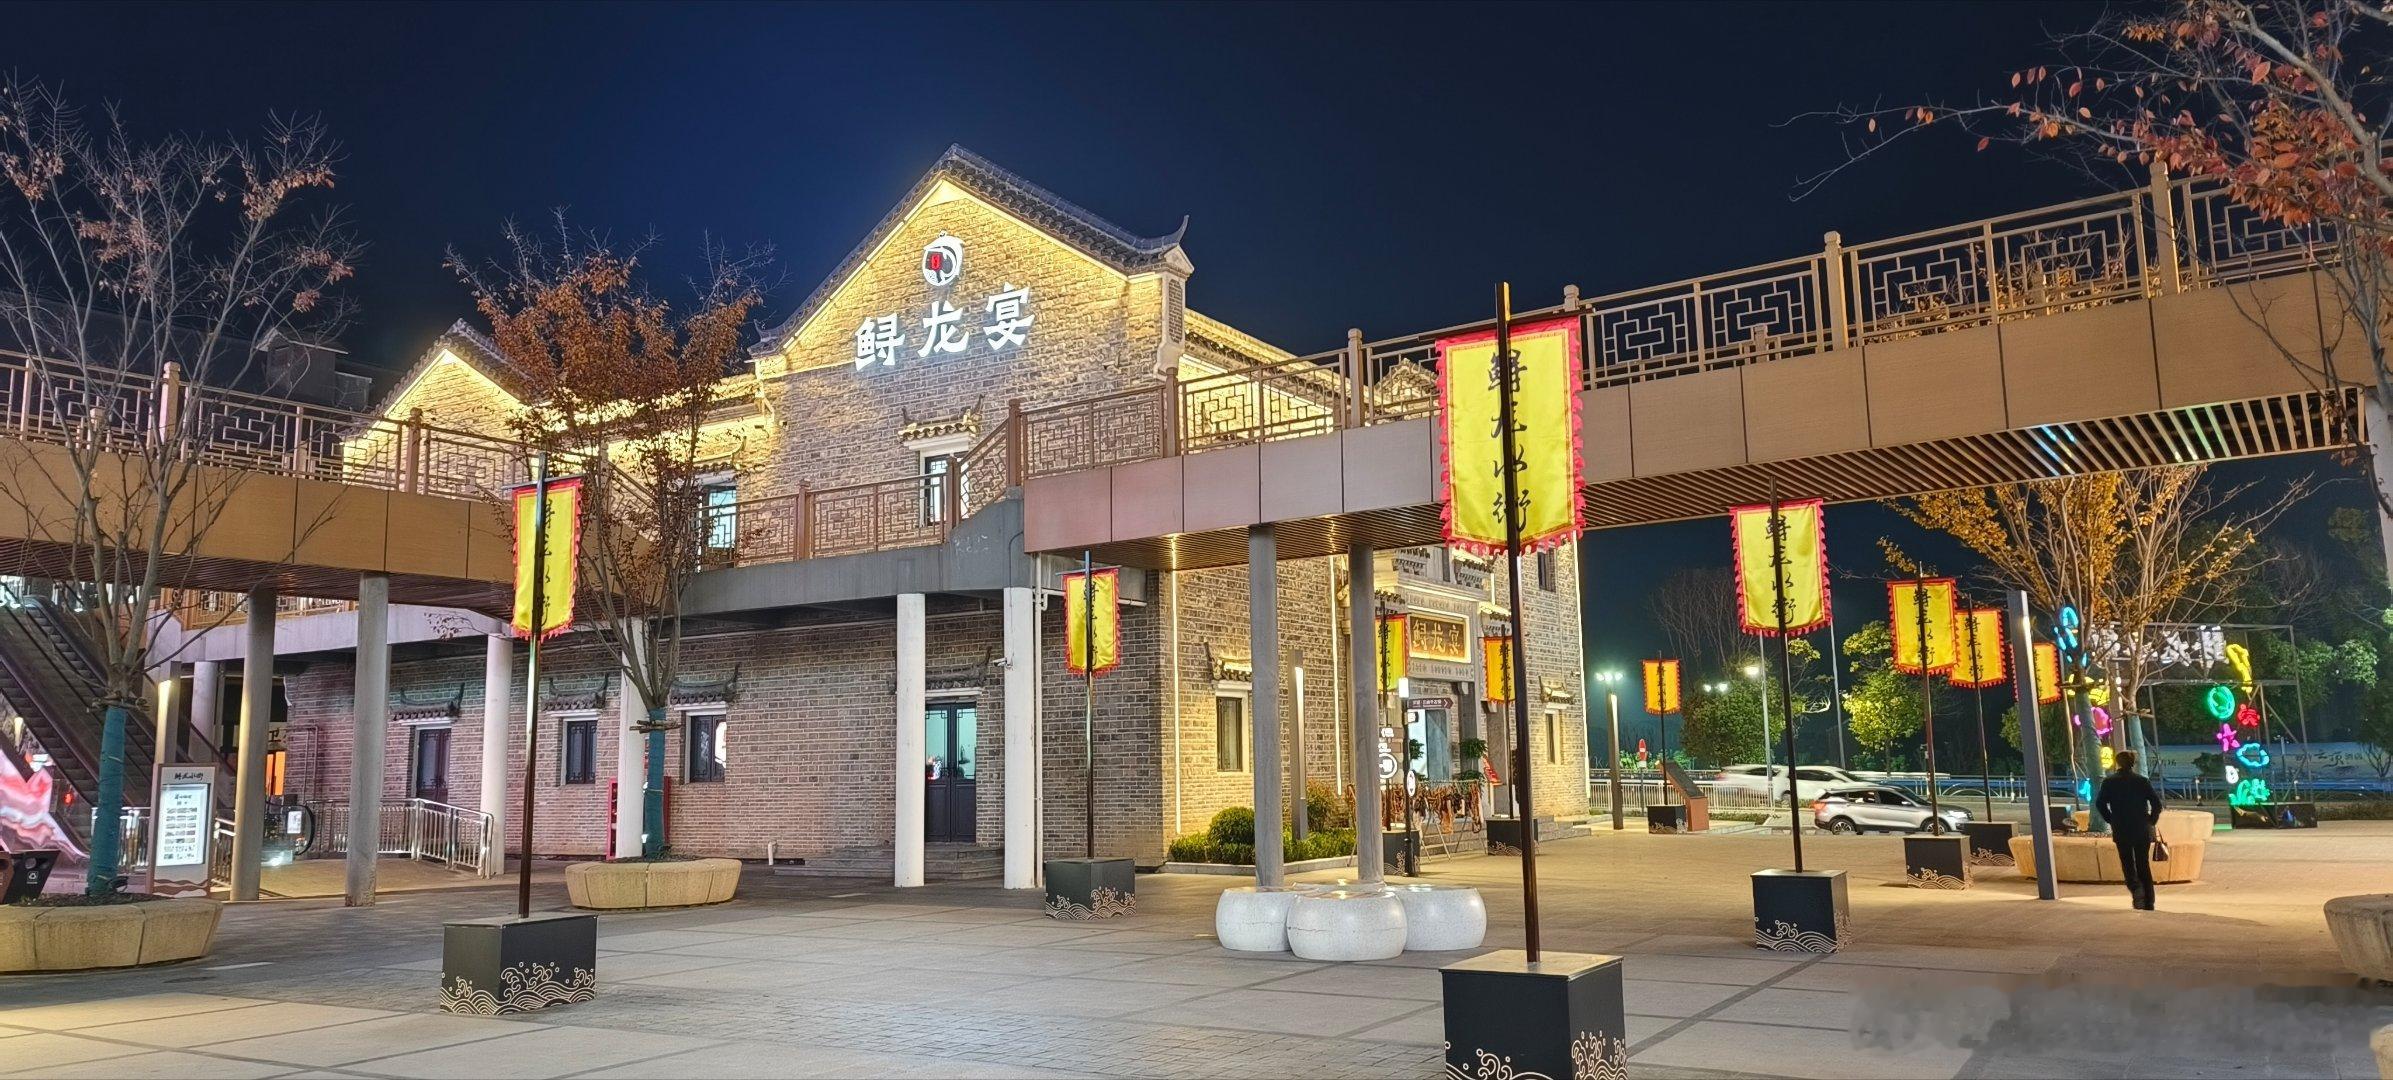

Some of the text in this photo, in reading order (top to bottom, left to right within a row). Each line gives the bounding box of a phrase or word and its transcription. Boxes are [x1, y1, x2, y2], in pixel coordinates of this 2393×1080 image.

[855, 282, 1035, 371] 鲟龙宴
[1412, 619, 1461, 656] 鲟龙宴
[268, 727, 289, 744] 卫
